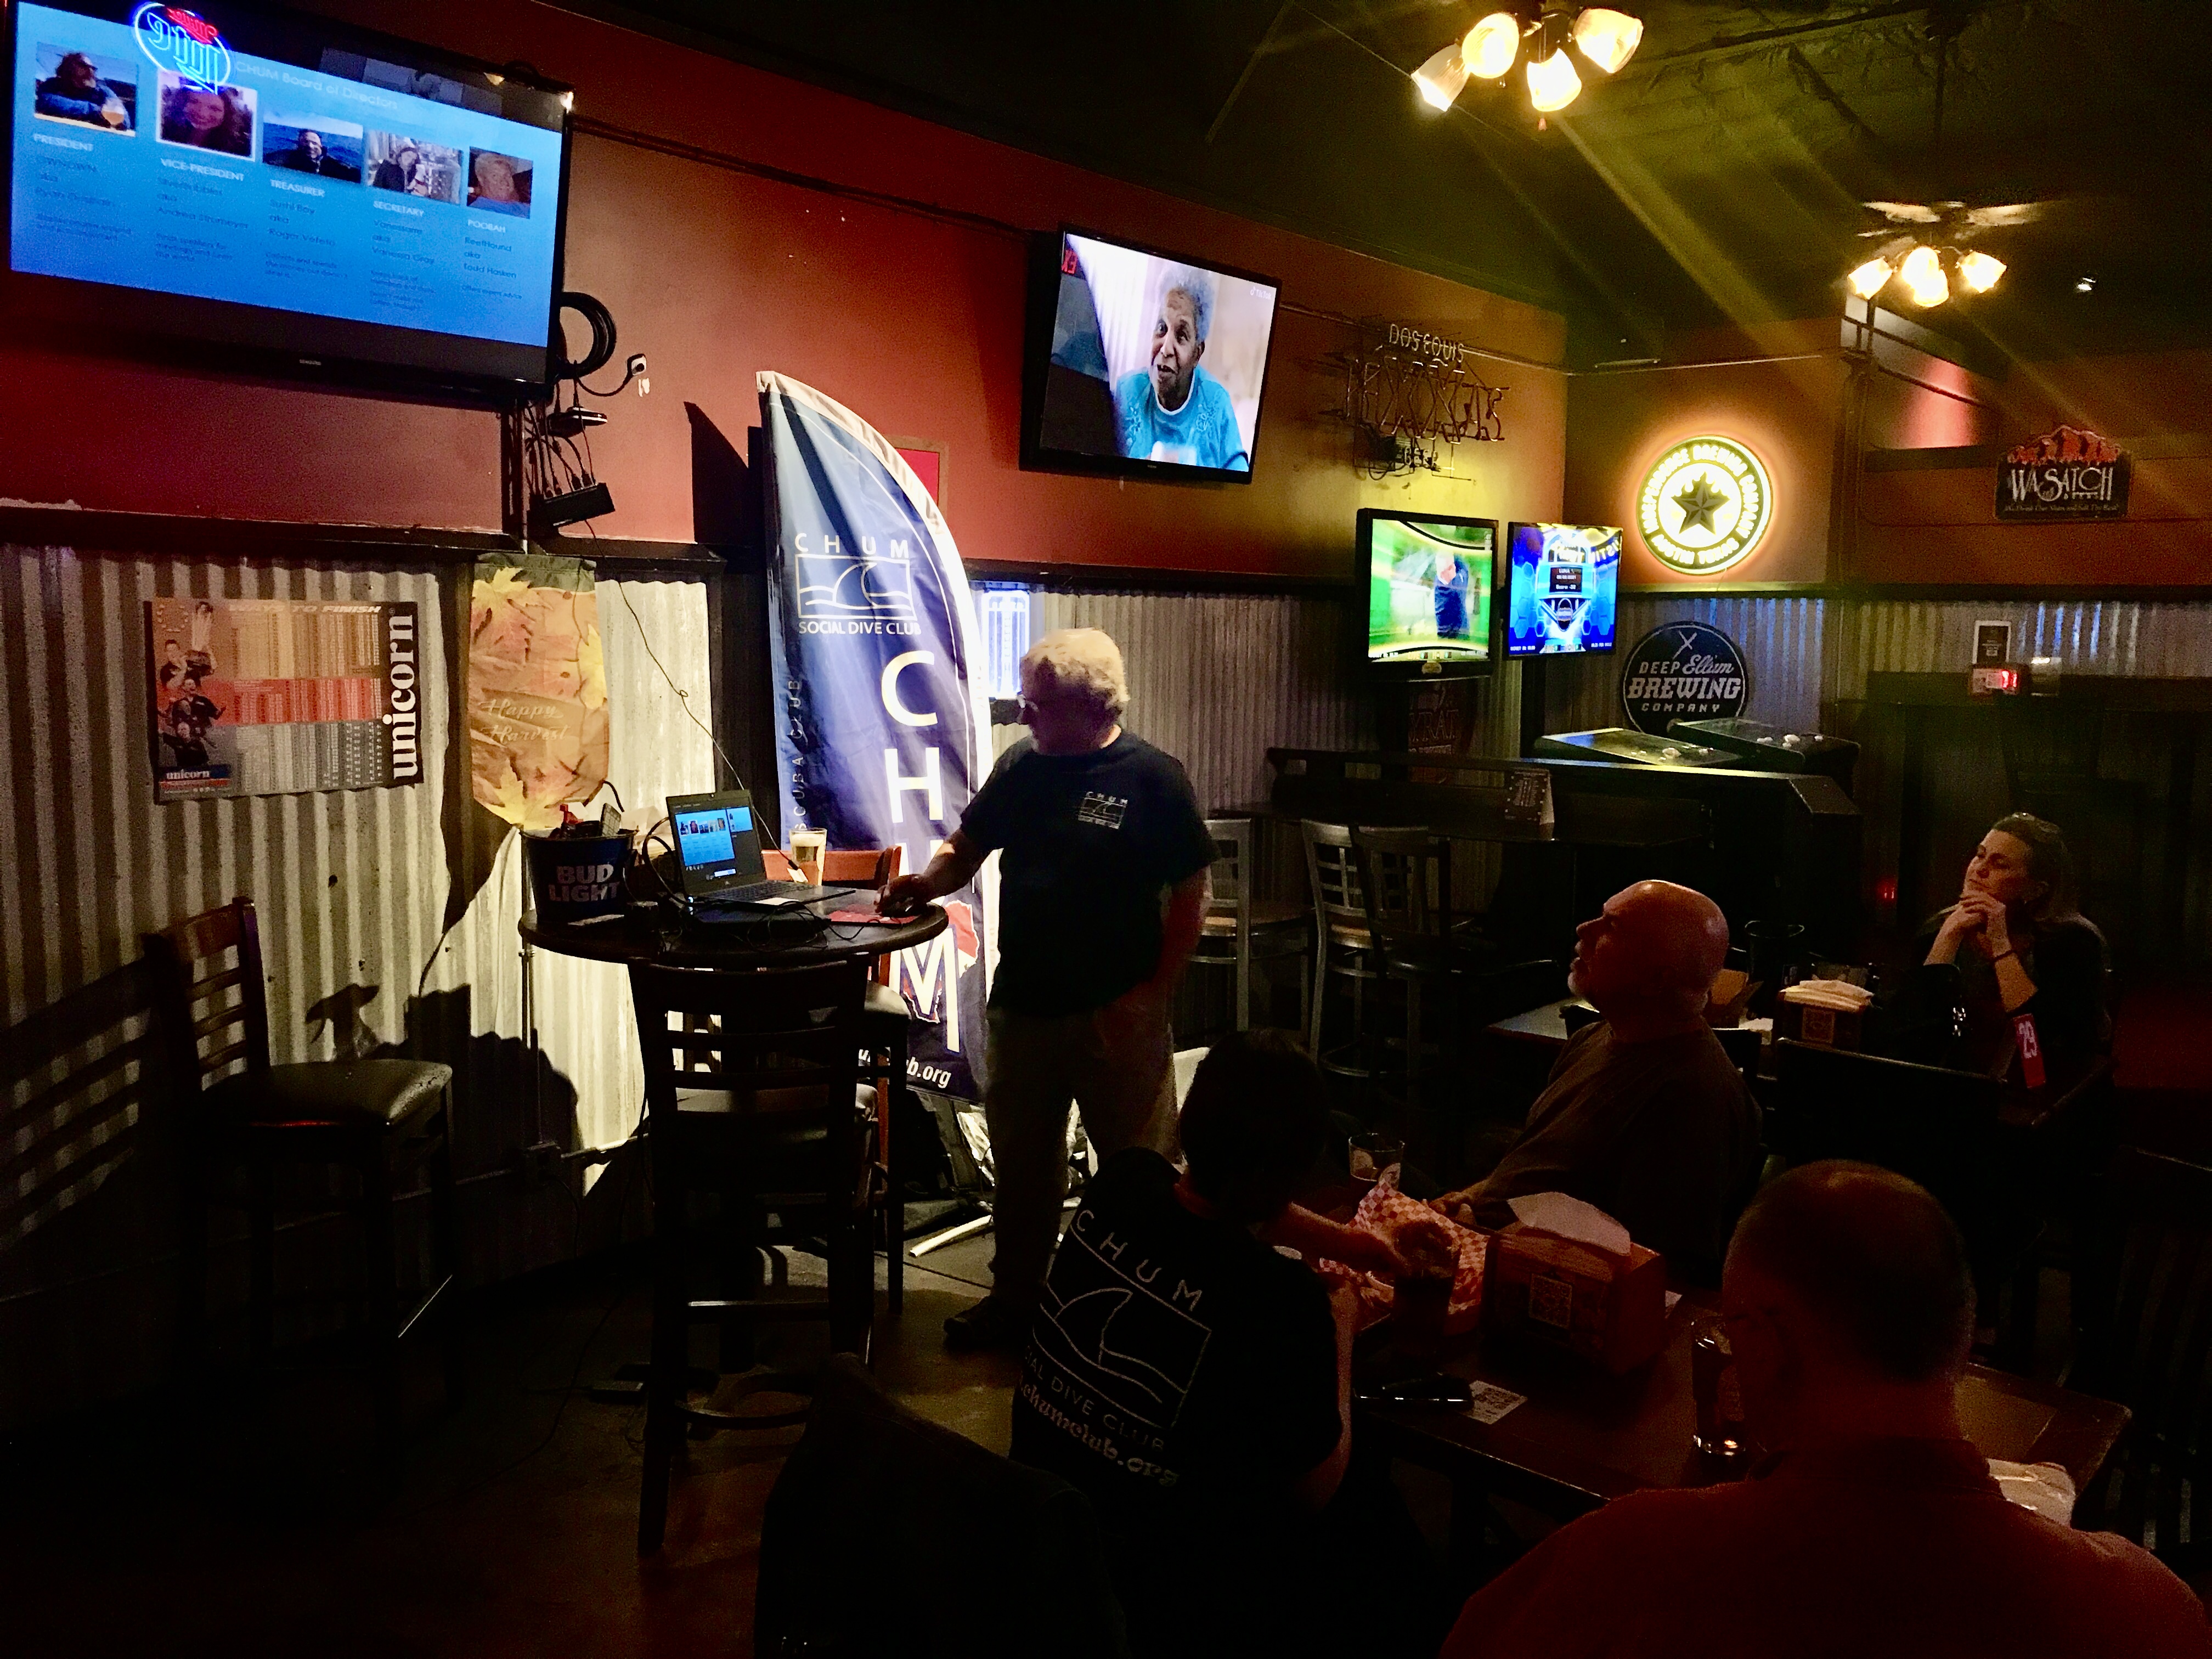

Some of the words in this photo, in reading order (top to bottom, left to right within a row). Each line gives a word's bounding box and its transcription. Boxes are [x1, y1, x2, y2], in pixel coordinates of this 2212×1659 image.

[236, 61, 279, 80] CHUM
[283, 72, 323, 91] Board
[33, 133, 94, 152] PRESIDENT
[161, 158, 245, 182] VICE-PRESIDENT
[270, 179, 326, 198] TREASURER
[373, 200, 425, 217] SECRETARY
[467, 219, 506, 234] POOBAH
[464, 251, 481, 259] aka
[1256, 289, 1272, 300] TikTok
[2012, 467, 2114, 502] WASATCH
[795, 533, 910, 558] CHUM
[1697, 537, 1740, 565] TEXAS
[321, 605, 382, 613] FINISH
[799, 622, 846, 635] SOCIAL
[848, 623, 883, 635] DIVE
[885, 623, 922, 636] CLUB
[1639, 661, 1681, 674] DEEP
[382, 614, 418, 780] unicorn
[1627, 678, 1741, 699] BREWING
[478, 698, 564, 720] Happy
[788, 680, 804, 740] CLUB
[1641, 703, 1720, 713] COMPANY
[481, 724, 571, 744] Harvest
[166, 769, 210, 780] unicorn
[556, 863, 614, 884] BUD
[549, 881, 620, 902] LIGHT
[1076, 1209, 1203, 1311] CHUM
[1051, 1375, 1095, 1416] DIVE
[1103, 1413, 1165, 1452] CLUB
